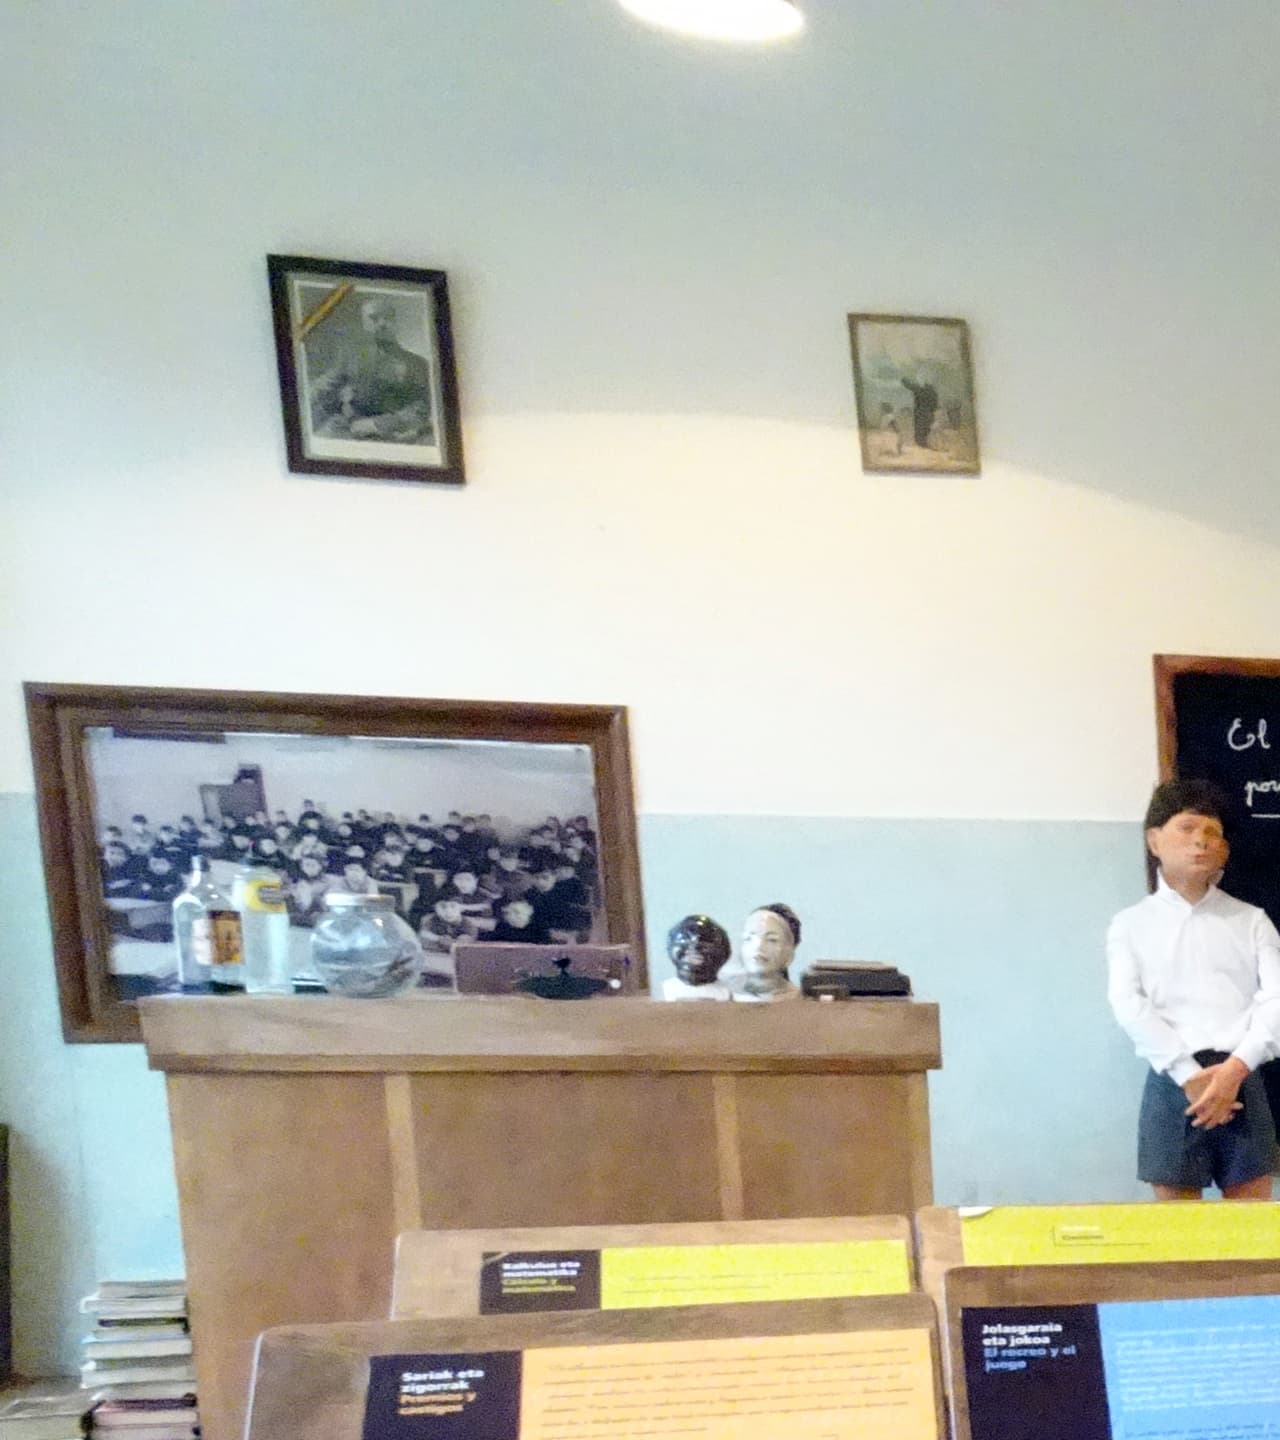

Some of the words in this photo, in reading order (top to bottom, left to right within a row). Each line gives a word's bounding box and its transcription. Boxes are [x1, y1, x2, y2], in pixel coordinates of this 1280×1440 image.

[1227, 718, 1271, 751] El
[982, 1336, 1007, 1347] eta
[1010, 1334, 1051, 1348] jokoa
